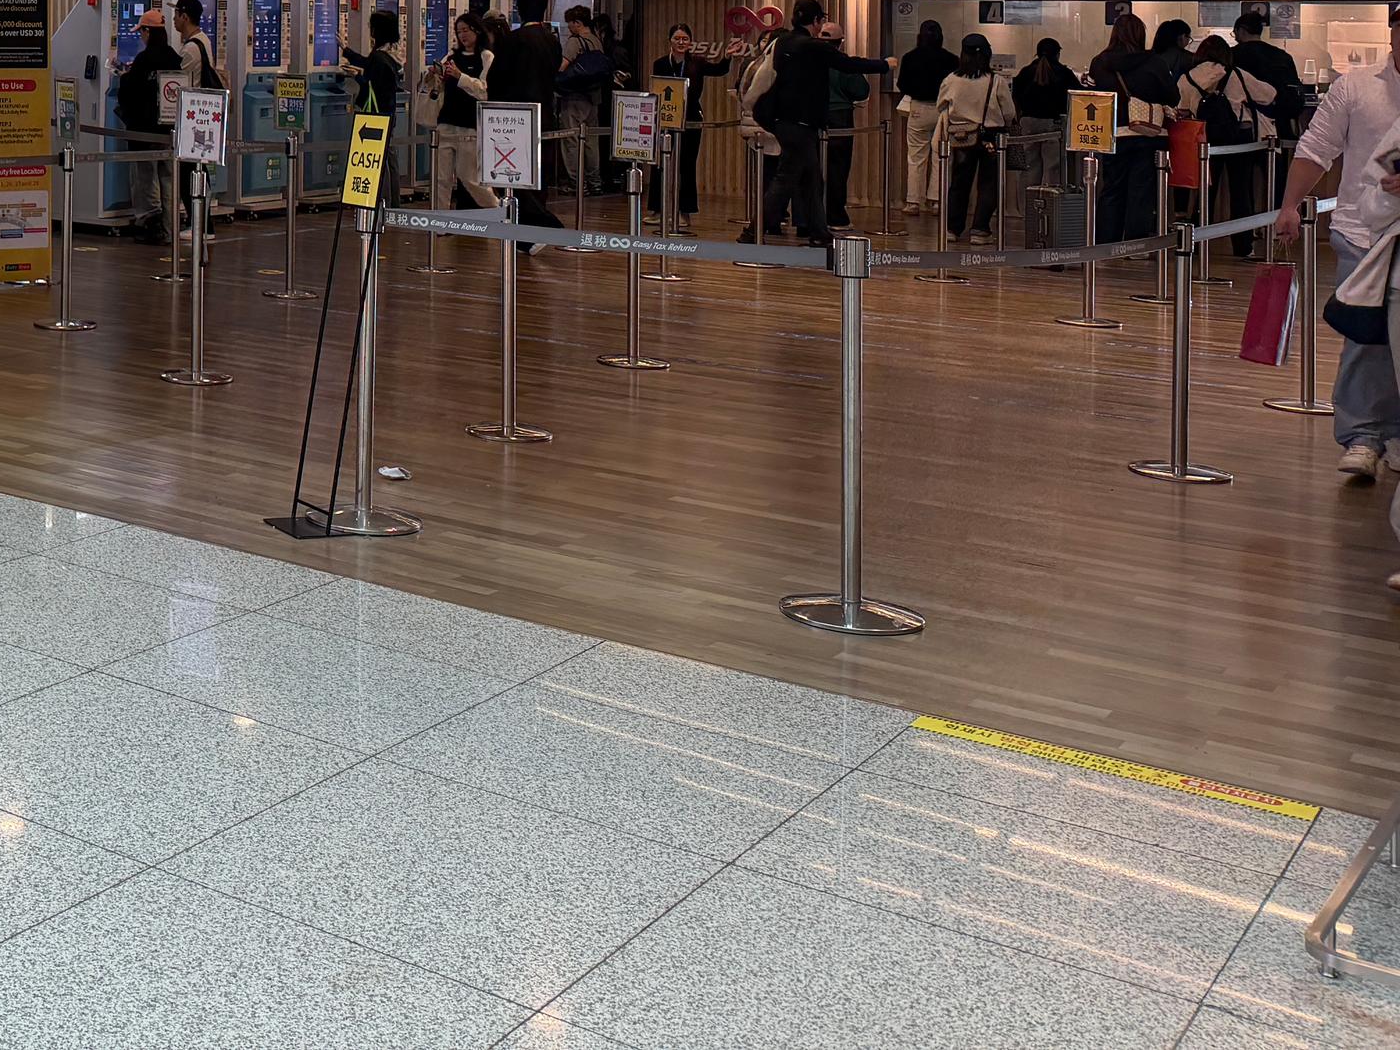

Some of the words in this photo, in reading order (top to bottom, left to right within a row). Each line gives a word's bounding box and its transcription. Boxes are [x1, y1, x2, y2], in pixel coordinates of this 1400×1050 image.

[986, 1, 1003, 22] 4
[15, 20, 43, 28] discount
[688, 41, 724, 61] asy
[1, 82, 10, 90] to
[10, 82, 24, 90] Use
[660, 104, 677, 112] ASH
[1076, 124, 1104, 133] CASH
[1079, 134, 1101, 145] 现金
[351, 151, 381, 170] CASH
[351, 176, 371, 195] 现金
[385, 210, 409, 226] 退税
[430, 220, 449, 229] Easy
[448, 221, 460, 229] Tax
[460, 222, 488, 232] Refund
[580, 233, 607, 248] 退税
[632, 241, 653, 250] Easy
[653, 242, 668, 251] Tax
[668, 243, 698, 252] Refund
